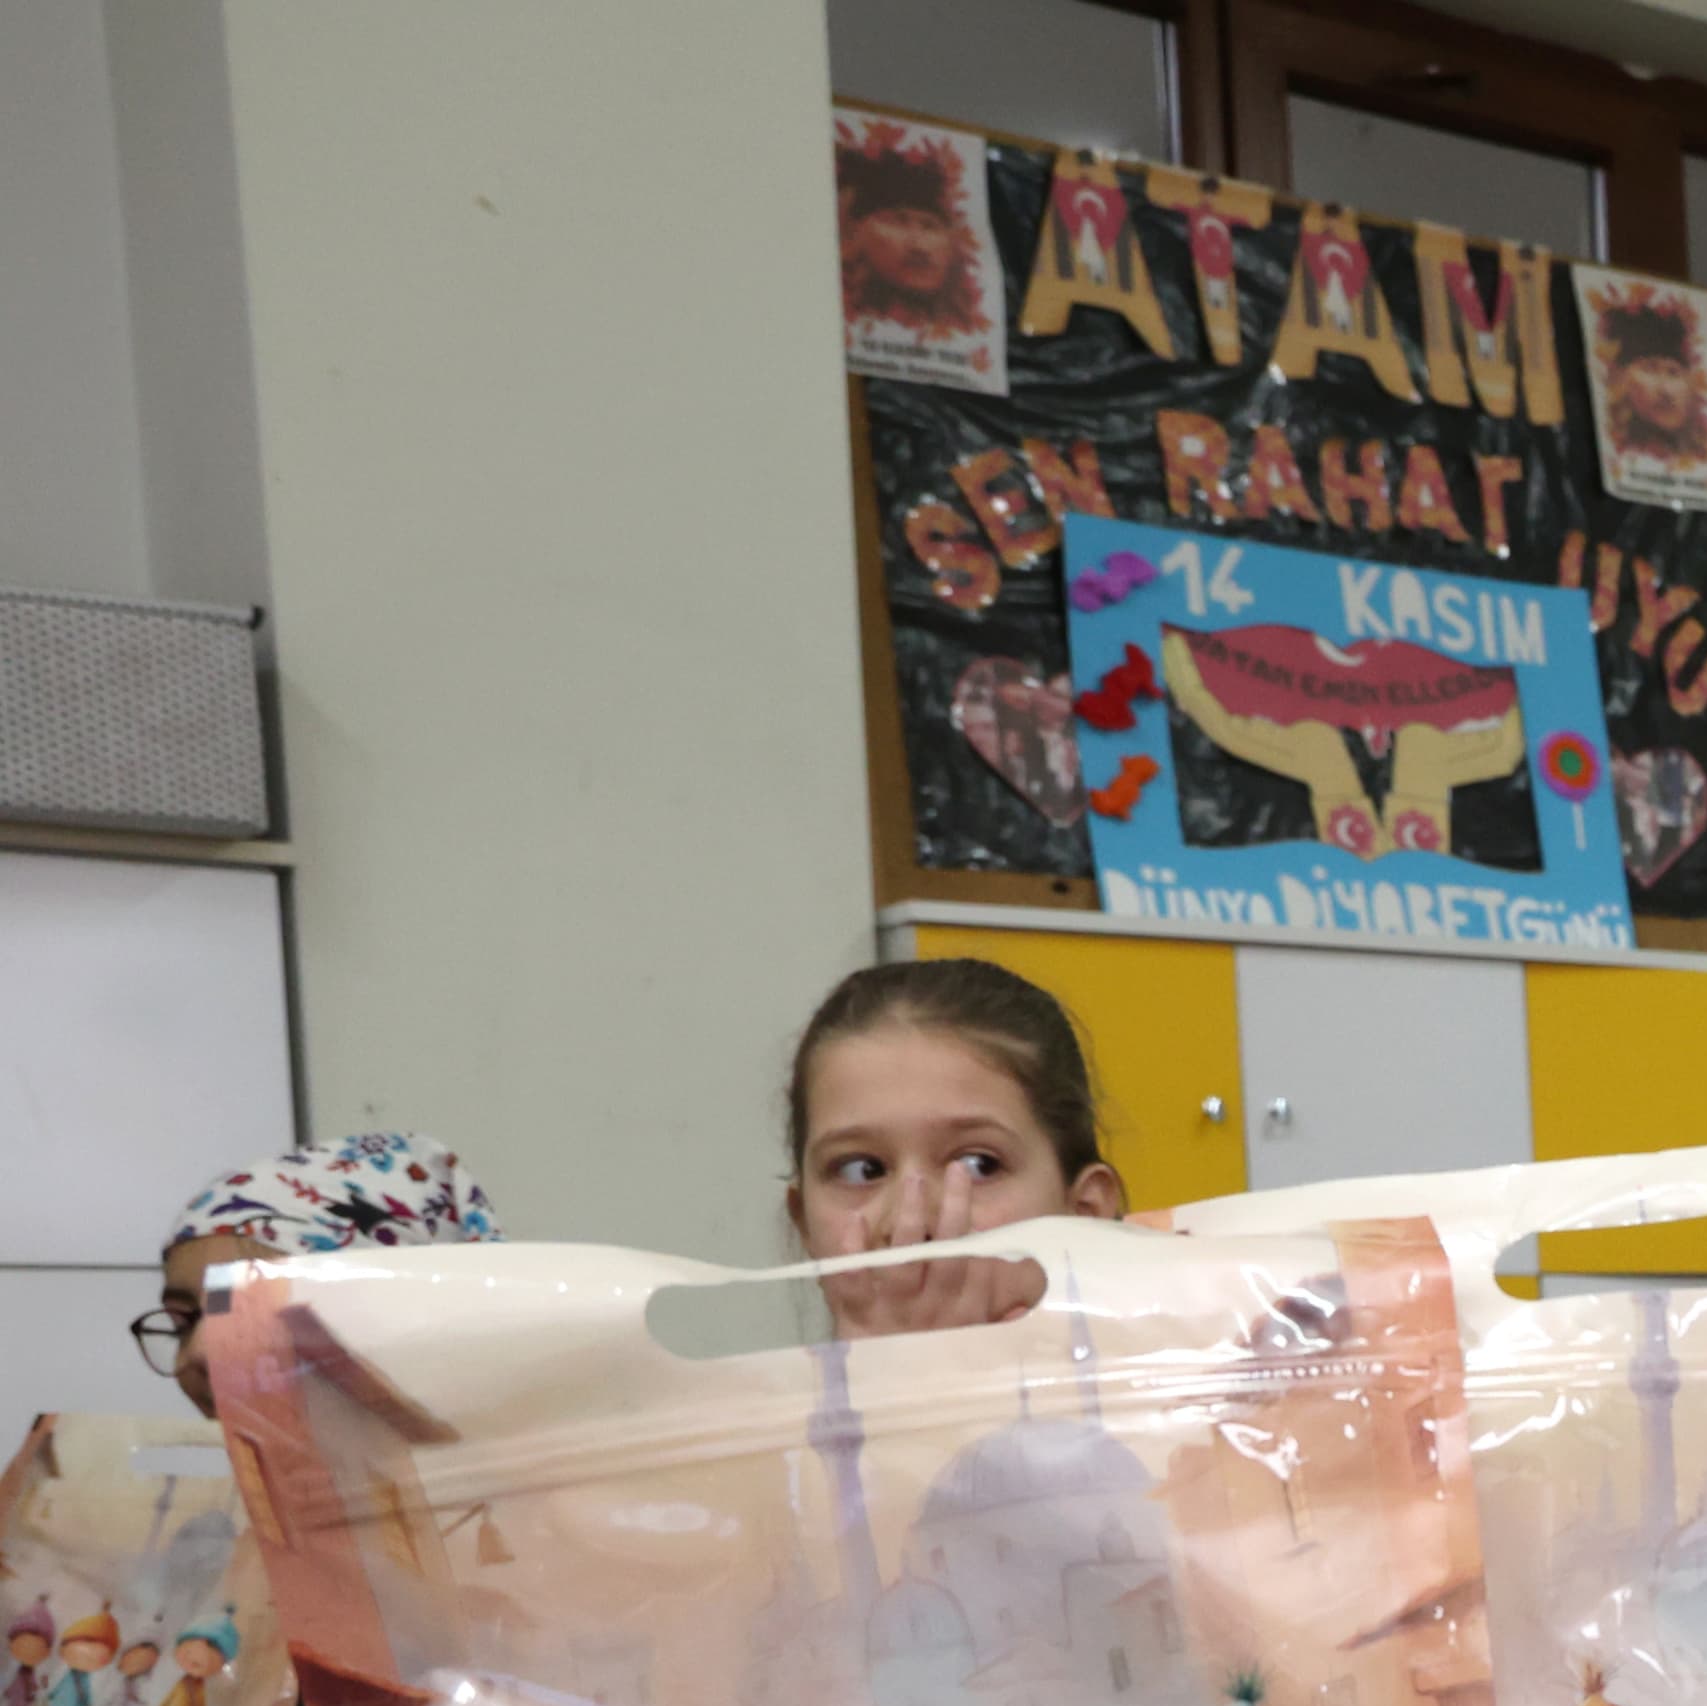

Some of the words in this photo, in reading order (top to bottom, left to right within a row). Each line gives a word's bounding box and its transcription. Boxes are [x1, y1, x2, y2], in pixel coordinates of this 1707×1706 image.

[1020, 148, 1565, 425] ATAM
[905, 435, 1115, 612] SEN
[1156, 409, 1522, 557] RAHAT
[1160, 540, 1254, 616] 14
[1338, 563, 1548, 667] KASIM
